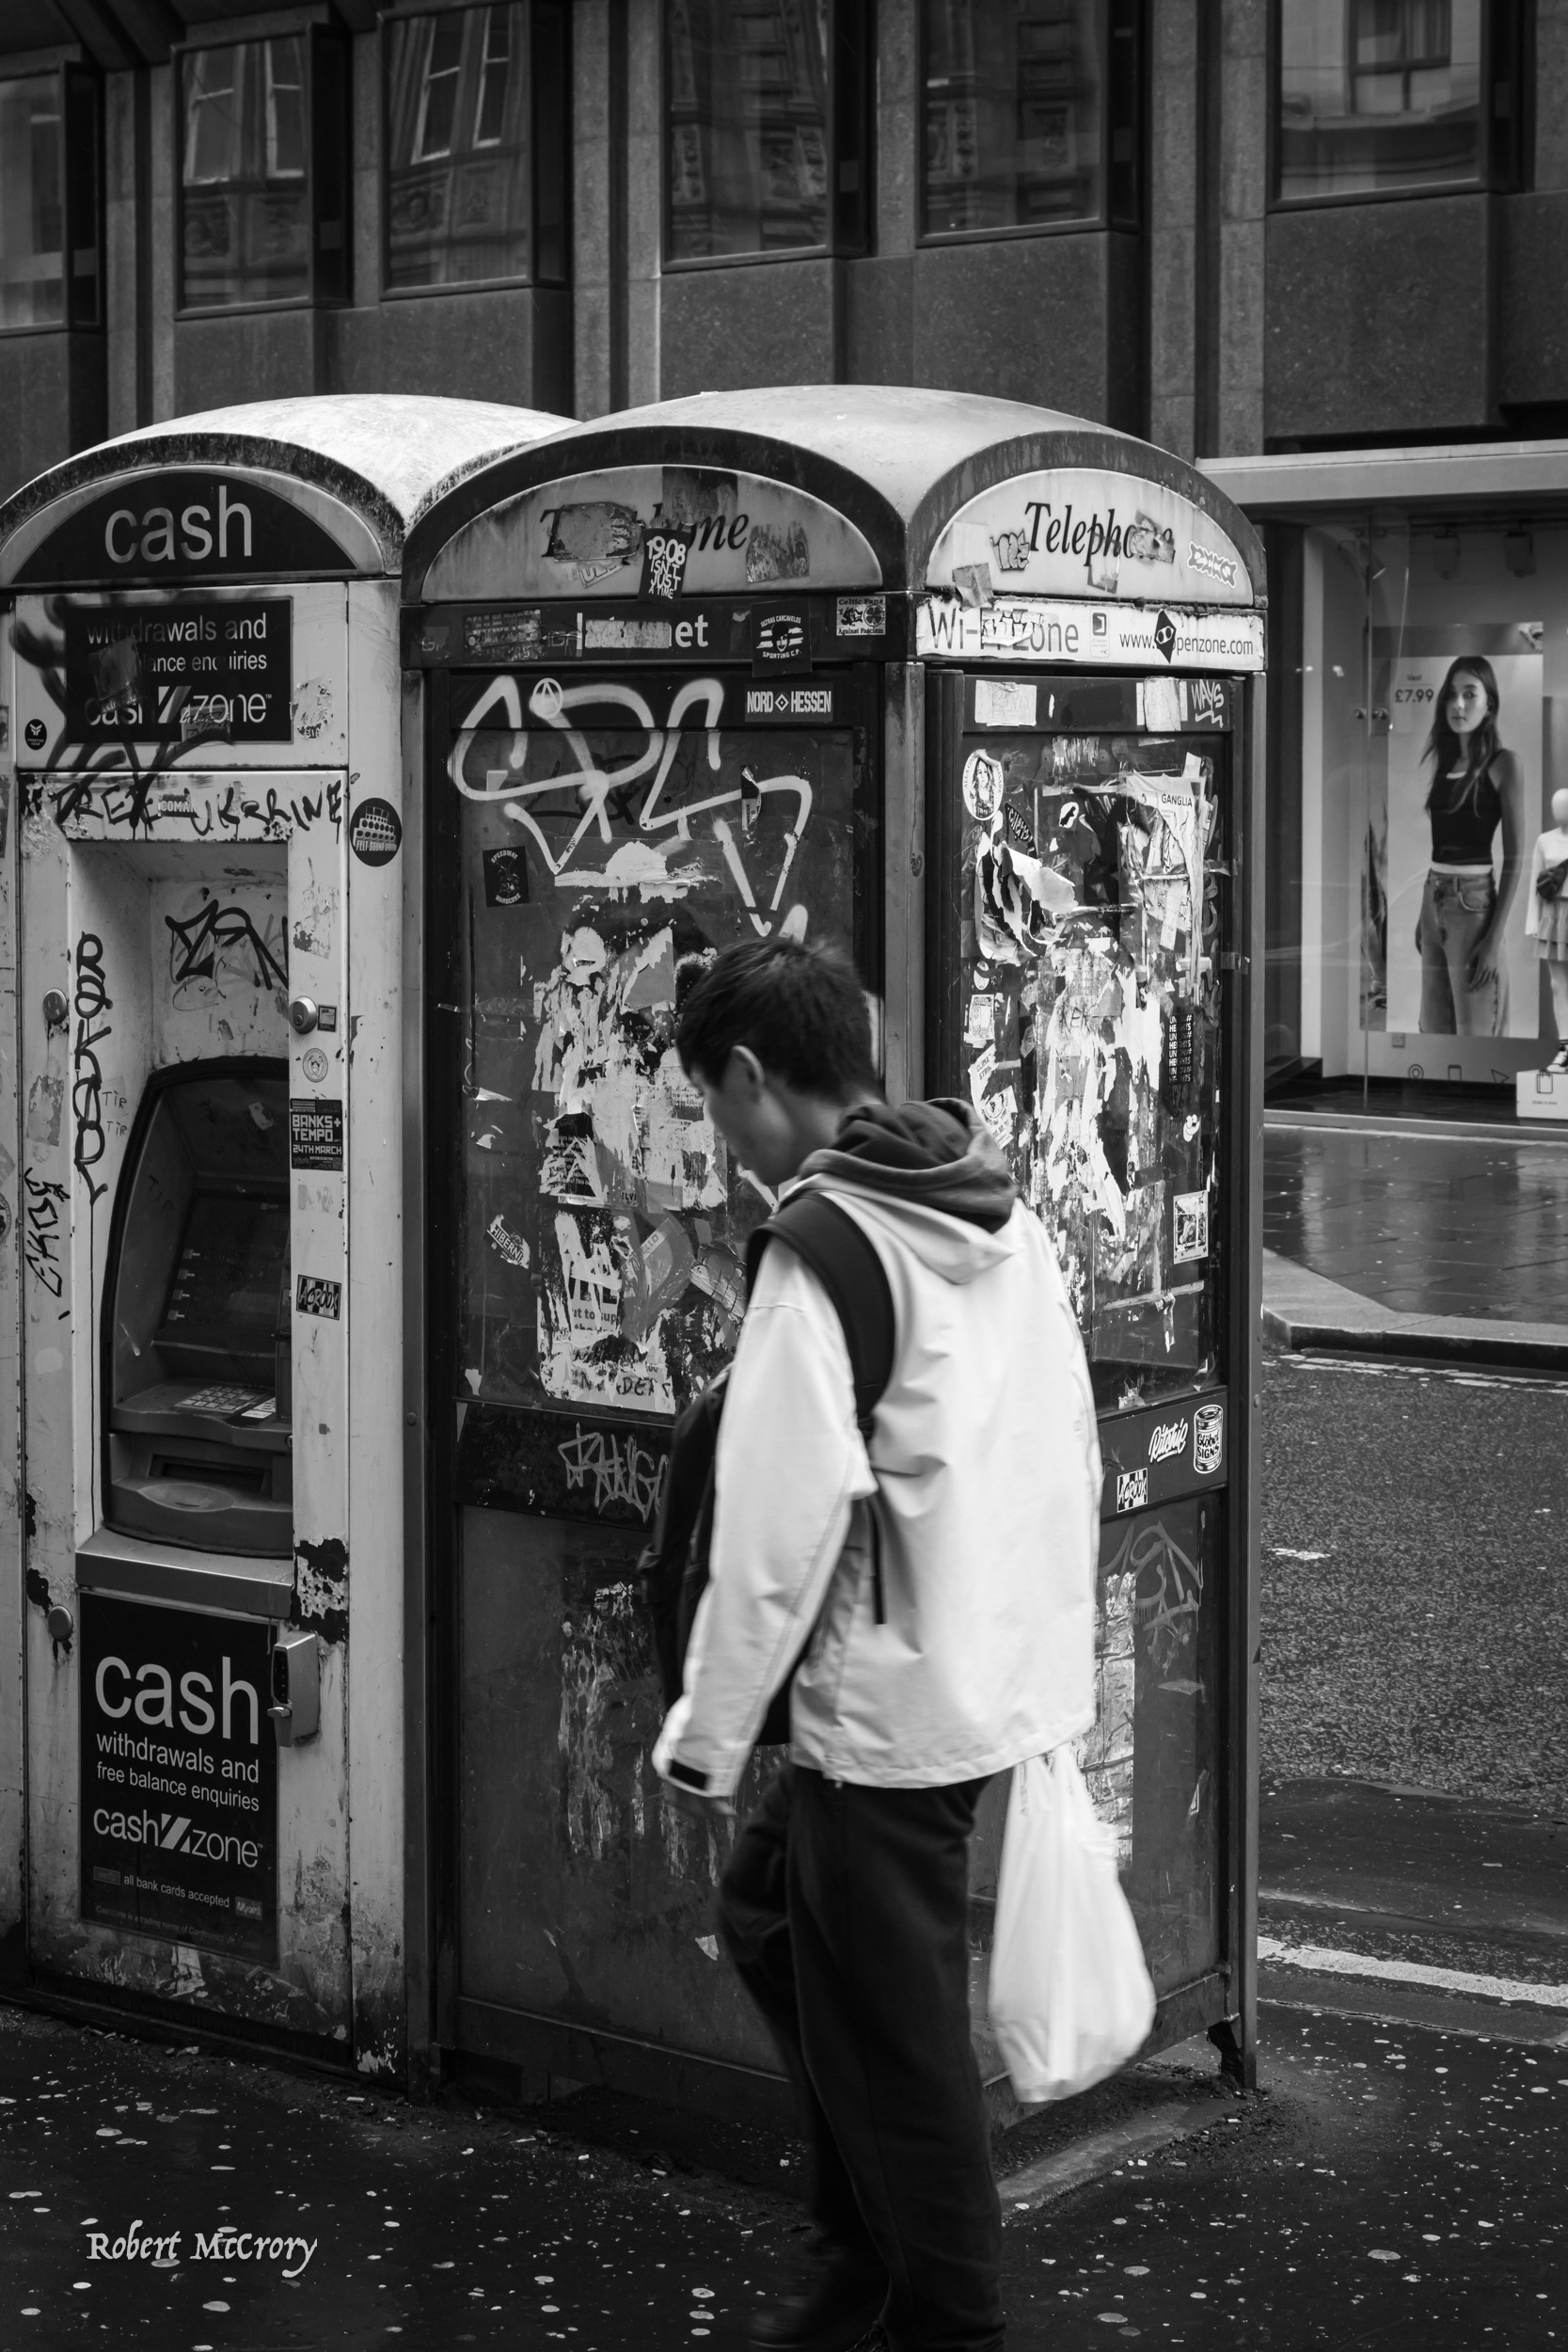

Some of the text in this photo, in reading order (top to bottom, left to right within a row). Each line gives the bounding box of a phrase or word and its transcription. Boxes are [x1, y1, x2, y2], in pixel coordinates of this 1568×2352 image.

[105, 485, 252, 563] cash
[1024, 501, 1174, 566] Telephoe
[646, 535, 687, 565] 19:08
[648, 579, 674, 599] A TIME
[653, 572, 681, 591] JUST
[87, 612, 267, 644] withdrawals and
[1119, 633, 1254, 656] www.penzone.com
[747, 691, 832, 713] NORD HESSEN
[1191, 679, 1224, 711] WAYS
[1395, 689, 1433, 703] £7.99
[1162, 793, 1193, 807] GANGLIA
[490, 850, 519, 864] SPEEDWAY
[495, 893, 521, 904] HARDCORE
[293, 1128, 333, 1142] TEMPO
[293, 1144, 342, 1155] 24TH MARCH
[584, 1309, 595, 1320] to
[1197, 1445, 1219, 1458] SIGNS
[95, 1656, 259, 1745] cash
[96, 1730, 259, 1784] withdrawals and
[97, 1761, 260, 1812] free balance enquiries
[93, 1807, 258, 1868] cash zone
[123, 1874, 135, 1886] all
[136, 1876, 158, 1892] bank
[160, 1884, 185, 1899] cards
[188, 1889, 230, 1908] accepted
